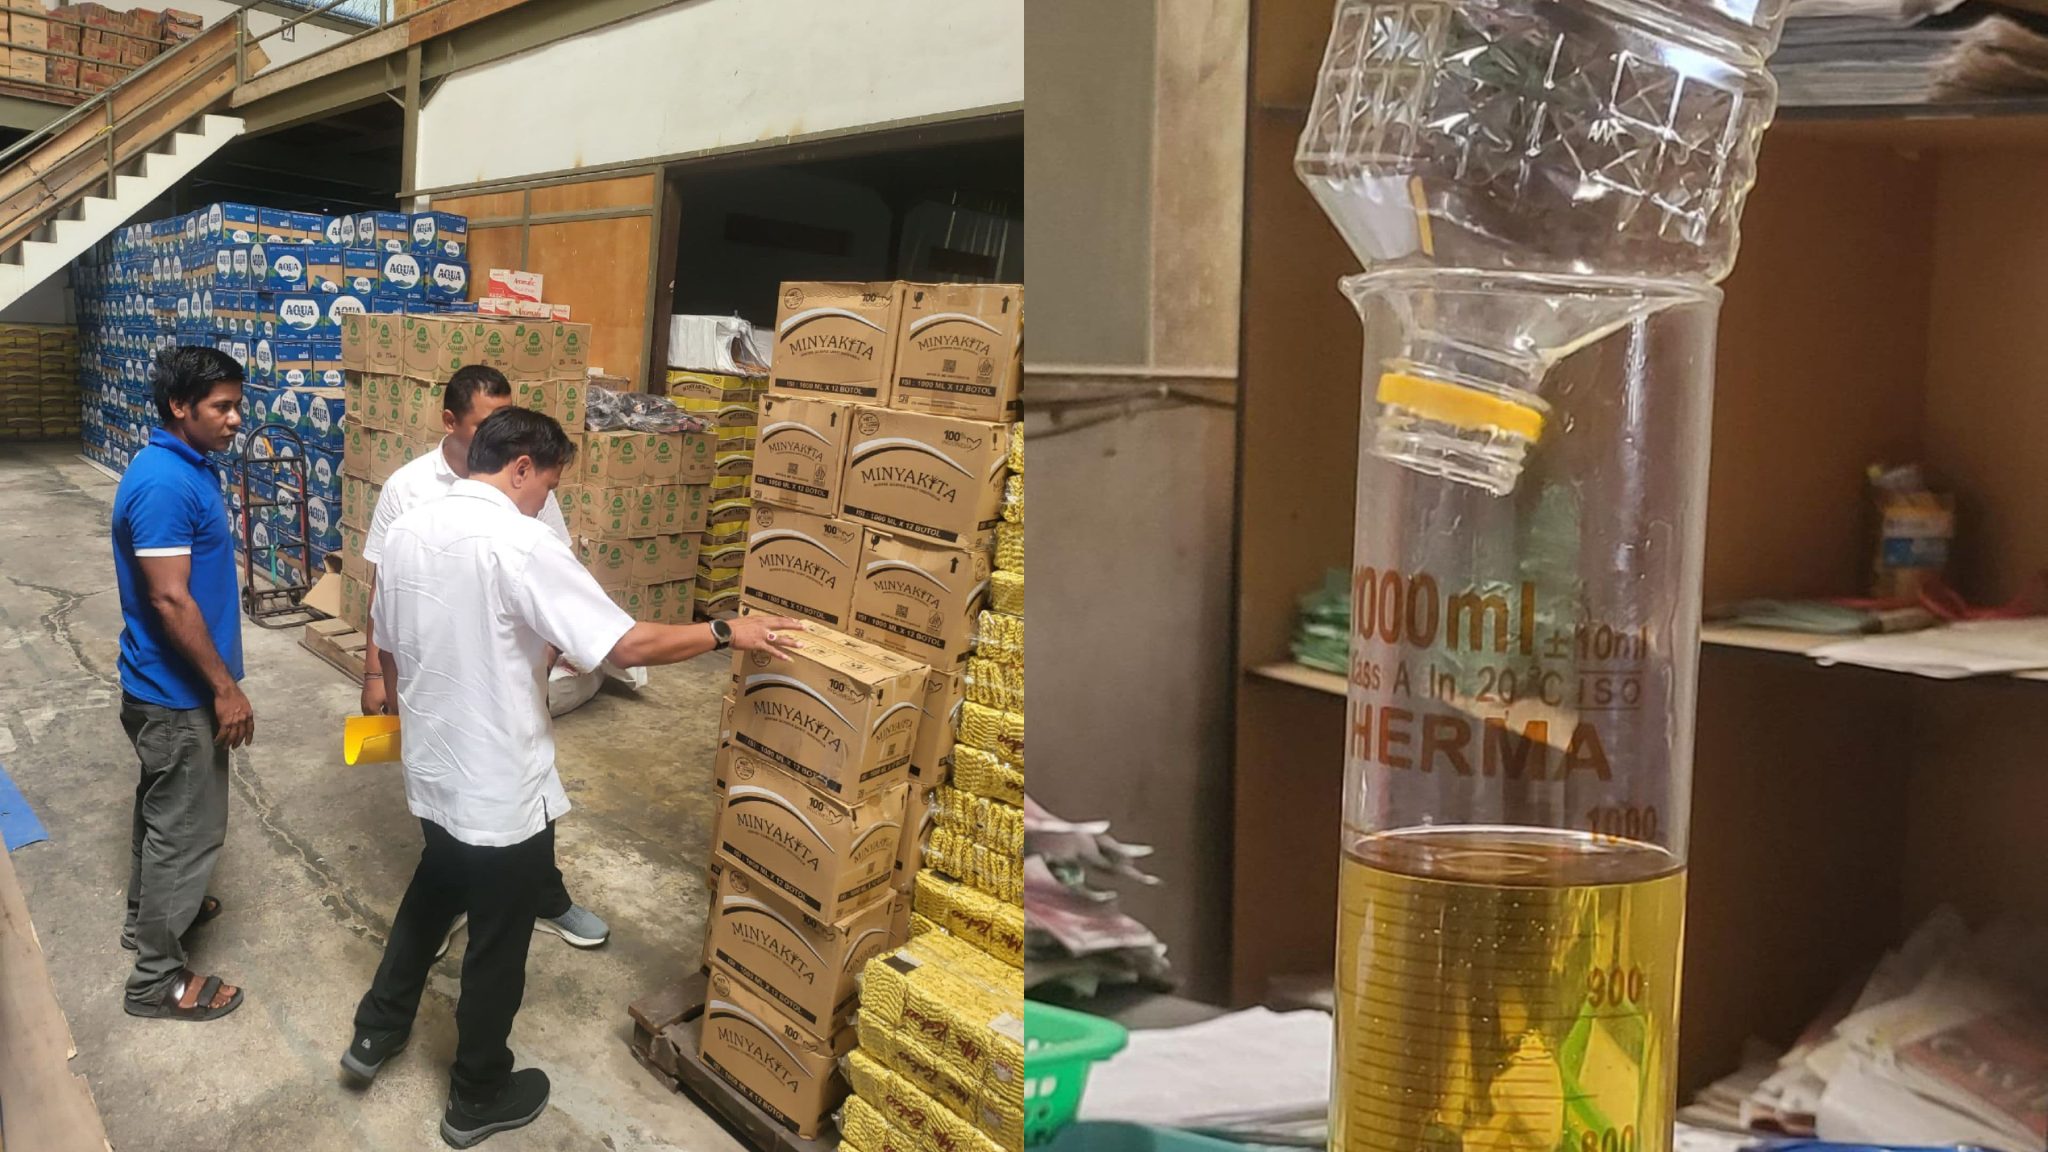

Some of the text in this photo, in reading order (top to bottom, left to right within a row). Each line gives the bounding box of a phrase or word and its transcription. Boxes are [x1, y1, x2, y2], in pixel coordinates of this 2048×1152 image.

[416, 223, 432, 234] AQUA
[278, 263, 299, 272] AQUA
[390, 263, 415, 276] AQUA
[438, 269, 461, 282] AQUA
[286, 304, 314, 318] AQUA
[789, 335, 874, 360] MINYAKITA
[917, 335, 990, 356] MINYAKITA
[839, 386, 862, 394] BOTOL
[901, 378, 911, 386] ISI
[934, 382, 945, 390] ML
[946, 383, 952, 391] X
[955, 384, 963, 392] 12
[965, 385, 992, 395] BOTOL
[312, 406, 328, 420] AQUA
[768, 441, 823, 462] MINYAKITA
[861, 466, 957, 503] MINYAKITA
[308, 505, 326, 523] AQUA
[887, 516, 896, 526] ML
[905, 521, 913, 530] 12
[914, 523, 940, 537] BOTOL
[759, 553, 836, 589] MINYAKITA
[873, 580, 940, 609] MINYAKITA
[888, 623, 896, 632] ML
[907, 629, 914, 638] 12
[916, 632, 940, 647] BOTOL
[1393, 659, 1411, 699] A
[1430, 663, 1457, 702] In
[1476, 665, 1517, 706] 20
[754, 700, 841, 753] MINYAKITA
[1350, 699, 1613, 783] HERMA
[801, 765, 826, 785] BOT
[1586, 804, 1657, 843] 1000
[736, 813, 819, 872] MINYAKITA
[784, 881, 807, 902] BOTOL
[731, 922, 815, 985] MINYAKITA
[1586, 966, 1644, 1008] 900
[718, 1026, 799, 1093] MINYAKITA
[762, 1097, 784, 1119] BOTOL
